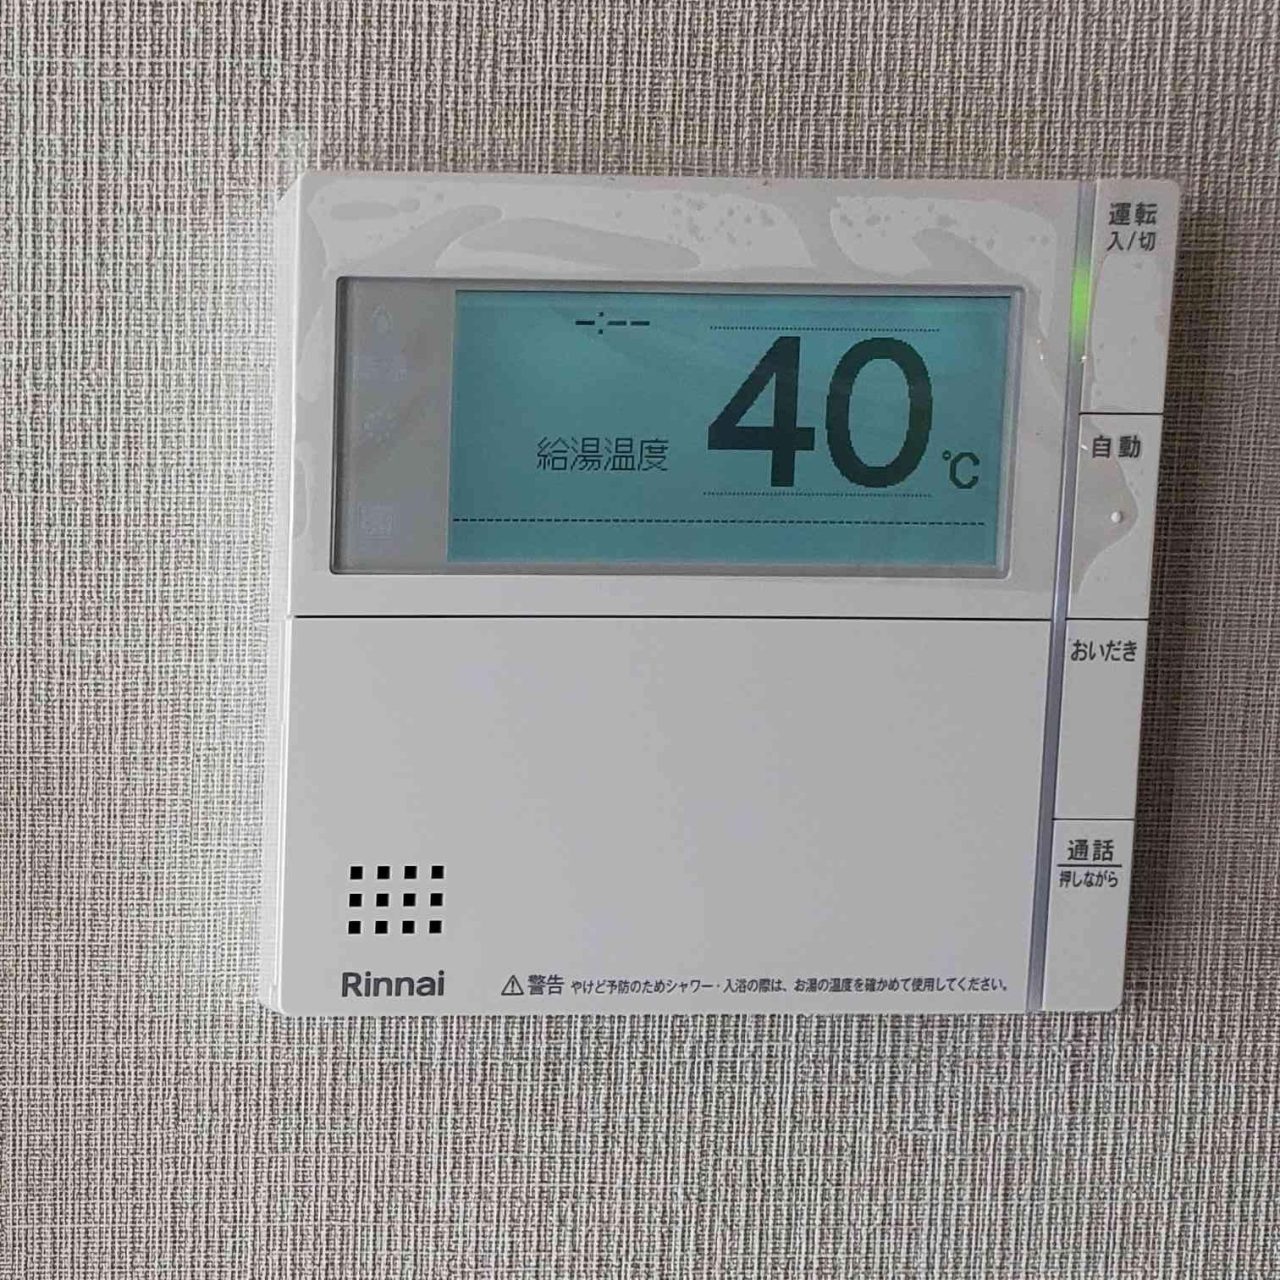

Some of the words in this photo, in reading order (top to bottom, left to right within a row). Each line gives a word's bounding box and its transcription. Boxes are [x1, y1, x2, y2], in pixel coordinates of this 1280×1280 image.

[1108, 202, 1157, 226] 運転
[1107, 231, 1156, 251] 入/切
[537, 437, 669, 472] 給湯温度
[707, 336, 933, 488] 40
[1092, 435, 1141, 459] 自動
[1070, 639, 1137, 662] おいだき
[1067, 839, 1114, 862] 通話
[1059, 870, 1118, 888] 押しながら
[341, 970, 445, 997] Rinnai
[528, 974, 564, 996] 警告
